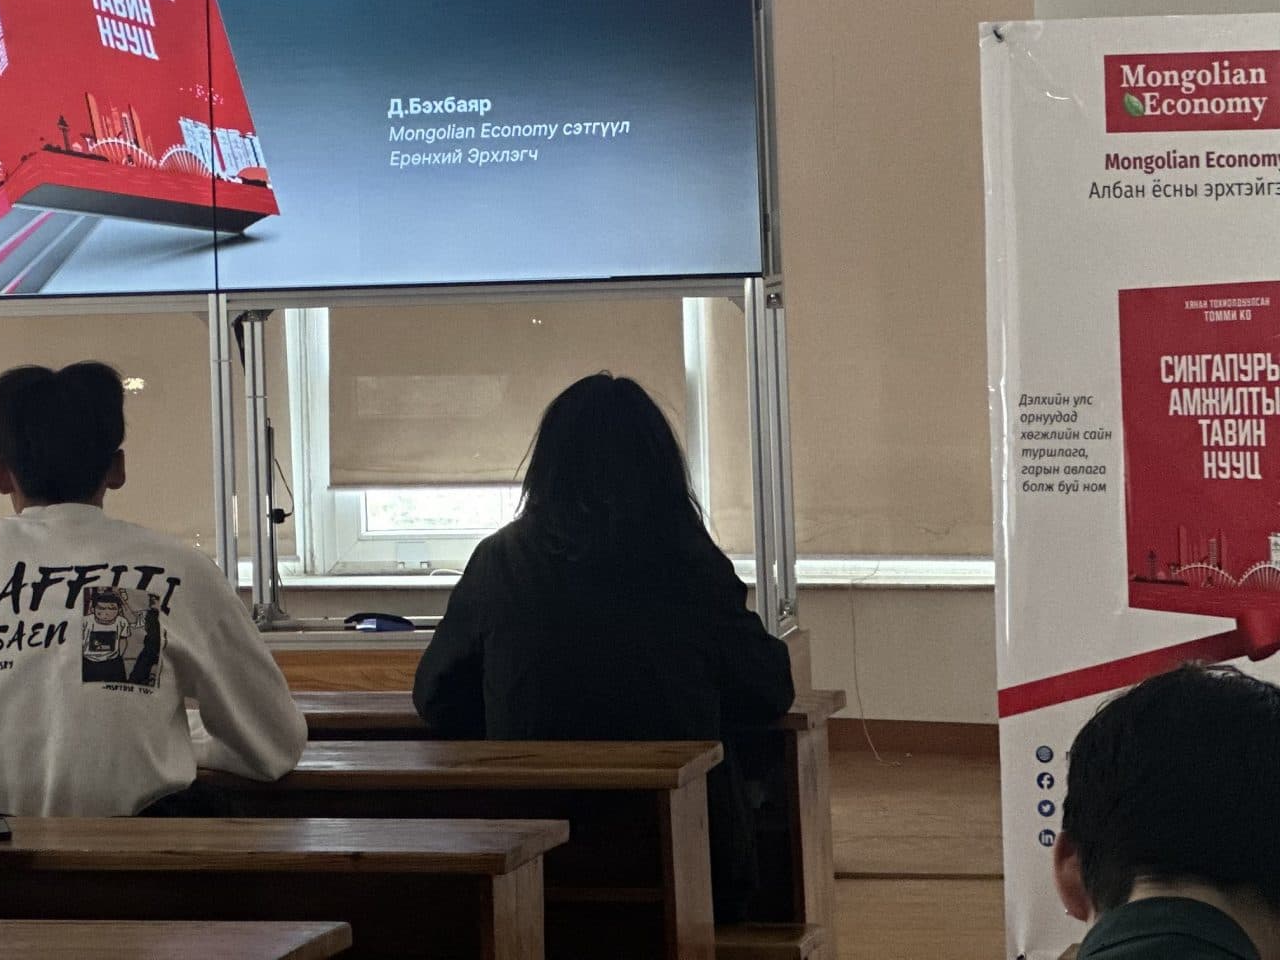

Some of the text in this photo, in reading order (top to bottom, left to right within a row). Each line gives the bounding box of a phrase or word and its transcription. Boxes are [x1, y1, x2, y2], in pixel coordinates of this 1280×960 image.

[96, 14, 160, 61] НУУЦ
[1120, 60, 1267, 94] Mongolian
[387, 96, 492, 118] Д.Бэхбаяр
[1142, 91, 1268, 121] Economy
[389, 120, 630, 143] Mongolian Economy сэтгүүл
[390, 147, 539, 168] Ерөнхий Эрхлэгч
[1105, 150, 1280, 174] Mongolian Econom
[1089, 181, 1145, 199] Албан
[1152, 179, 1198, 198] ёсны
[1204, 309, 1252, 321] ТОММИ КО
[1018, 393, 1094, 408] Дэлхийн улс
[1020, 410, 1078, 425] орнуудад
[1020, 428, 1112, 440] хөгжлийн сайн
[1198, 418, 1266, 447] ТАВИН
[1022, 448, 1088, 460] туршлага,
[1021, 465, 1106, 477] гарын авлага
[1203, 450, 1263, 480] НУУЦ
[1023, 479, 1107, 495] болж буй ном
